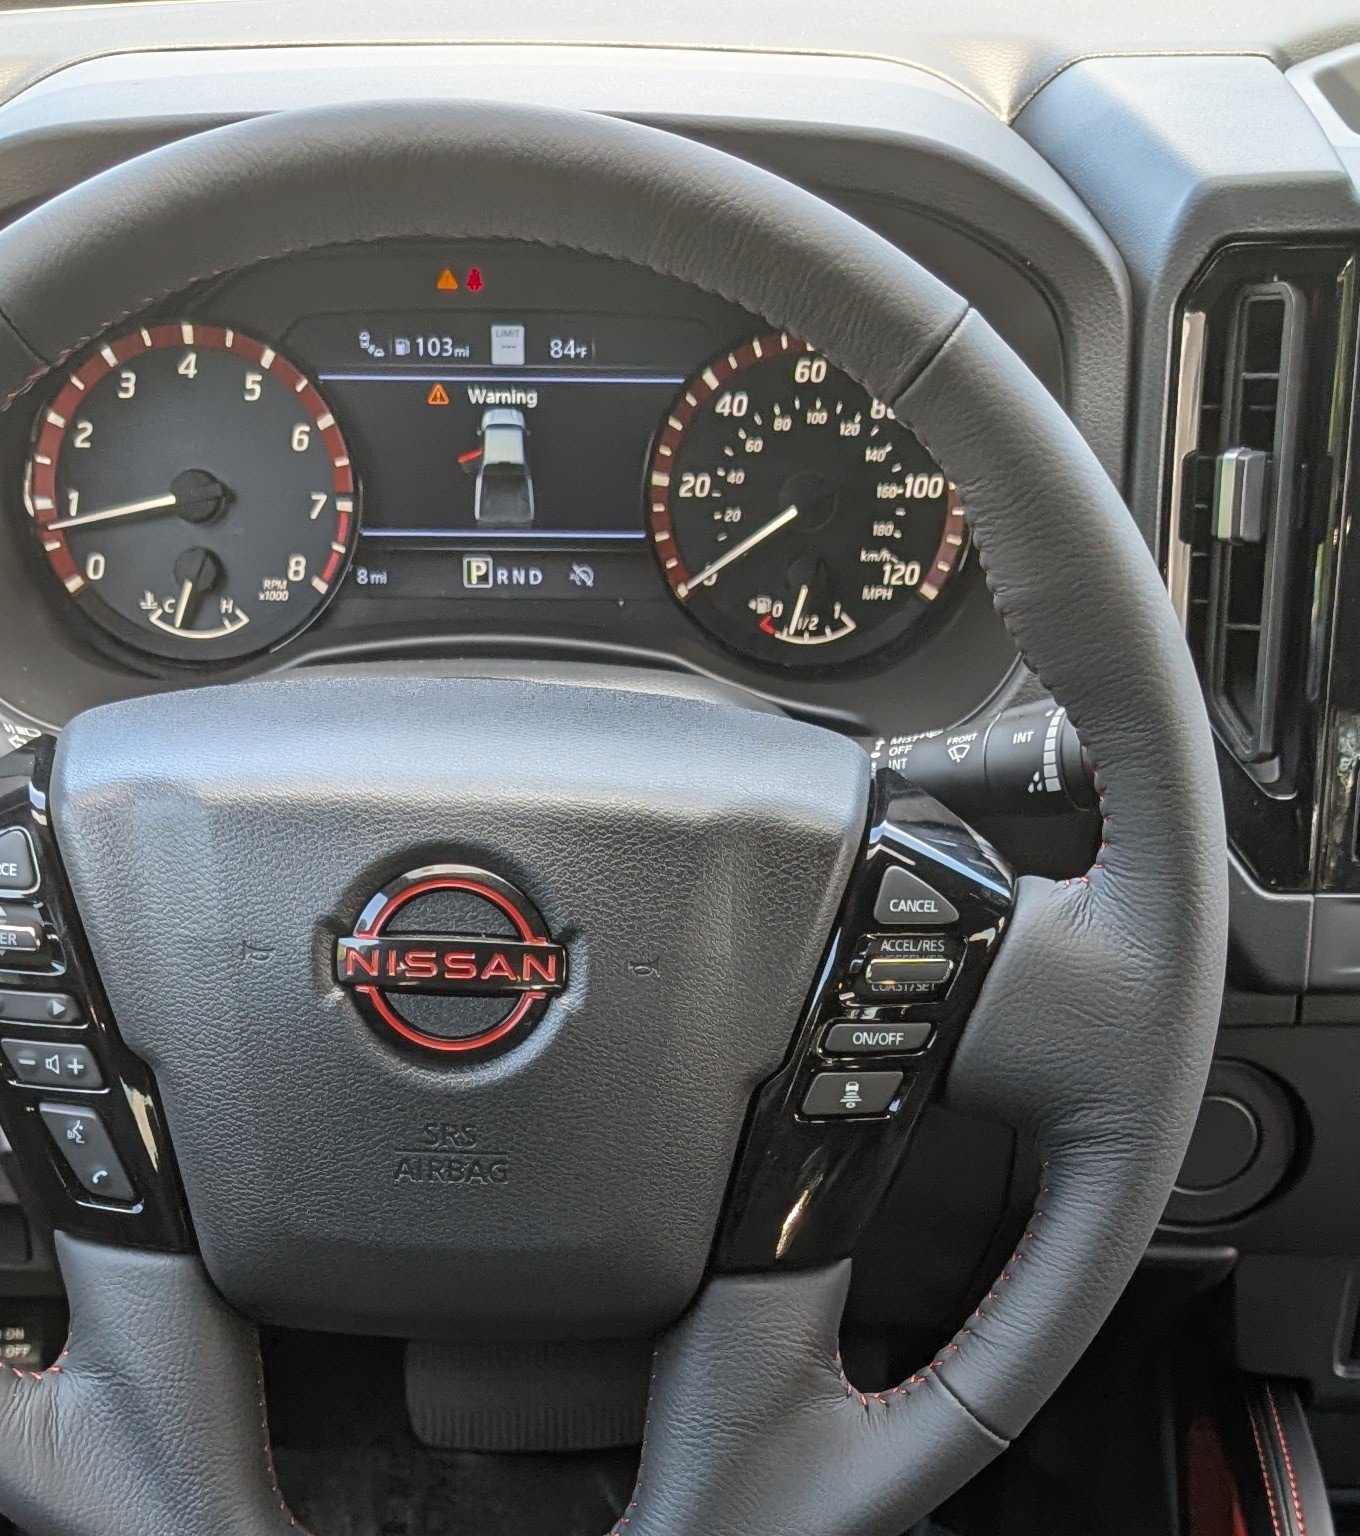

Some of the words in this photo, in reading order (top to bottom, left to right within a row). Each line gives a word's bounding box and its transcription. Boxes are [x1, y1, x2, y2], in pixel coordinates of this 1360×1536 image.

[495, 329, 520, 339] LIMIT
[177, 352, 197, 379] 4
[794, 357, 828, 384] 60
[117, 371, 137, 400] 3
[244, 372, 263, 401] 5
[467, 385, 539, 409] Warning
[715, 391, 749, 418] 40
[773, 416, 792, 432] 80
[806, 410, 828, 425] 100
[73, 421, 93, 449] 2
[840, 422, 861, 436] 120
[291, 424, 310, 452] 6
[745, 439, 763, 453] 60
[865, 449, 886, 462] 140
[679, 473, 712, 498] 20
[727, 470, 745, 485] 40
[904, 476, 944, 499] 100
[67, 488, 79, 517] 1
[310, 493, 327, 520] 7
[724, 508, 742, 522] 20
[872, 521, 895, 537] 180
[860, 548, 891, 562] km/h
[86, 553, 105, 581] 0
[287, 554, 307, 582] 8
[471, 560, 487, 584] P
[496, 570, 508, 585] R
[513, 570, 525, 585] N
[530, 570, 543, 585] D
[882, 562, 921, 585] 120
[262, 580, 288, 591] RPM
[862, 586, 893, 601] MPH
[258, 590, 289, 602] x1000
[163, 599, 175, 615] C
[219, 599, 234, 615] H
[771, 603, 783, 618] 0
[797, 617, 820, 631] 1/2
[946, 732, 978, 746] FRONT
[1013, 731, 1035, 744] INT
[888, 744, 913, 757] OFF
[888, 757, 908, 771] INT
[889, 898, 939, 913] CANCEL
[880, 938, 946, 953] ACCEL/RES
[344, 948, 557, 983] NISSAN
[851, 1032, 905, 1047] ON/OFF
[421, 1122, 479, 1149] SRS
[394, 1159, 509, 1186] AIRBAG
